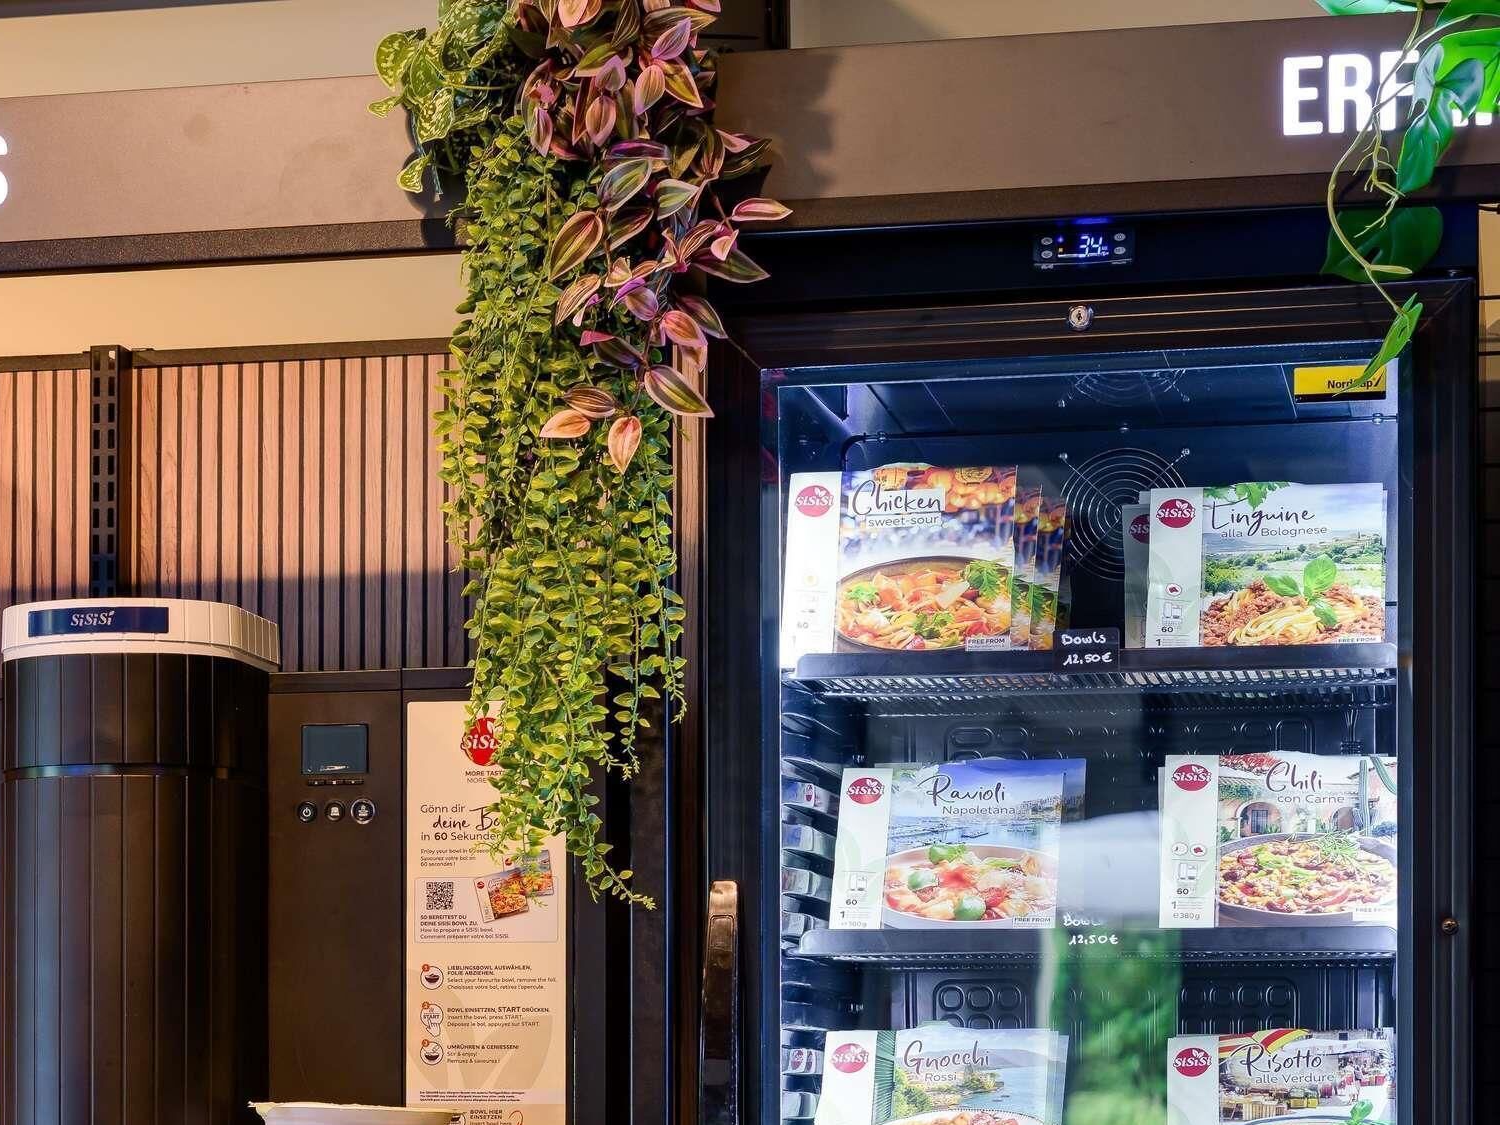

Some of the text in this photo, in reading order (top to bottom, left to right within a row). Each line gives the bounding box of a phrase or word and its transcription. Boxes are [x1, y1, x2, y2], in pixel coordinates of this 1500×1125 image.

[1327, 379, 1373, 391] Nordap
[851, 479, 941, 517] Chicken
[868, 514, 941, 528] sweet-sour
[1210, 500, 1315, 538] Linguine
[1220, 524, 1328, 539] alla Bolognese
[1265, 760, 1323, 794] Chili
[917, 774, 1006, 807] Ravioli
[1277, 793, 1345, 804] con Carne
[420, 803, 465, 814] Gönn dir
[942, 804, 1015, 816] Napoletana
[432, 806, 500, 831] deine Bo
[420, 831, 499, 841] in 60 Sekunde
[903, 1039, 991, 1075] Gnocchi
[1232, 1044, 1323, 1076] Risotto
[924, 1072, 958, 1082] Rossi
[1255, 1072, 1335, 1084] alle Verdure
